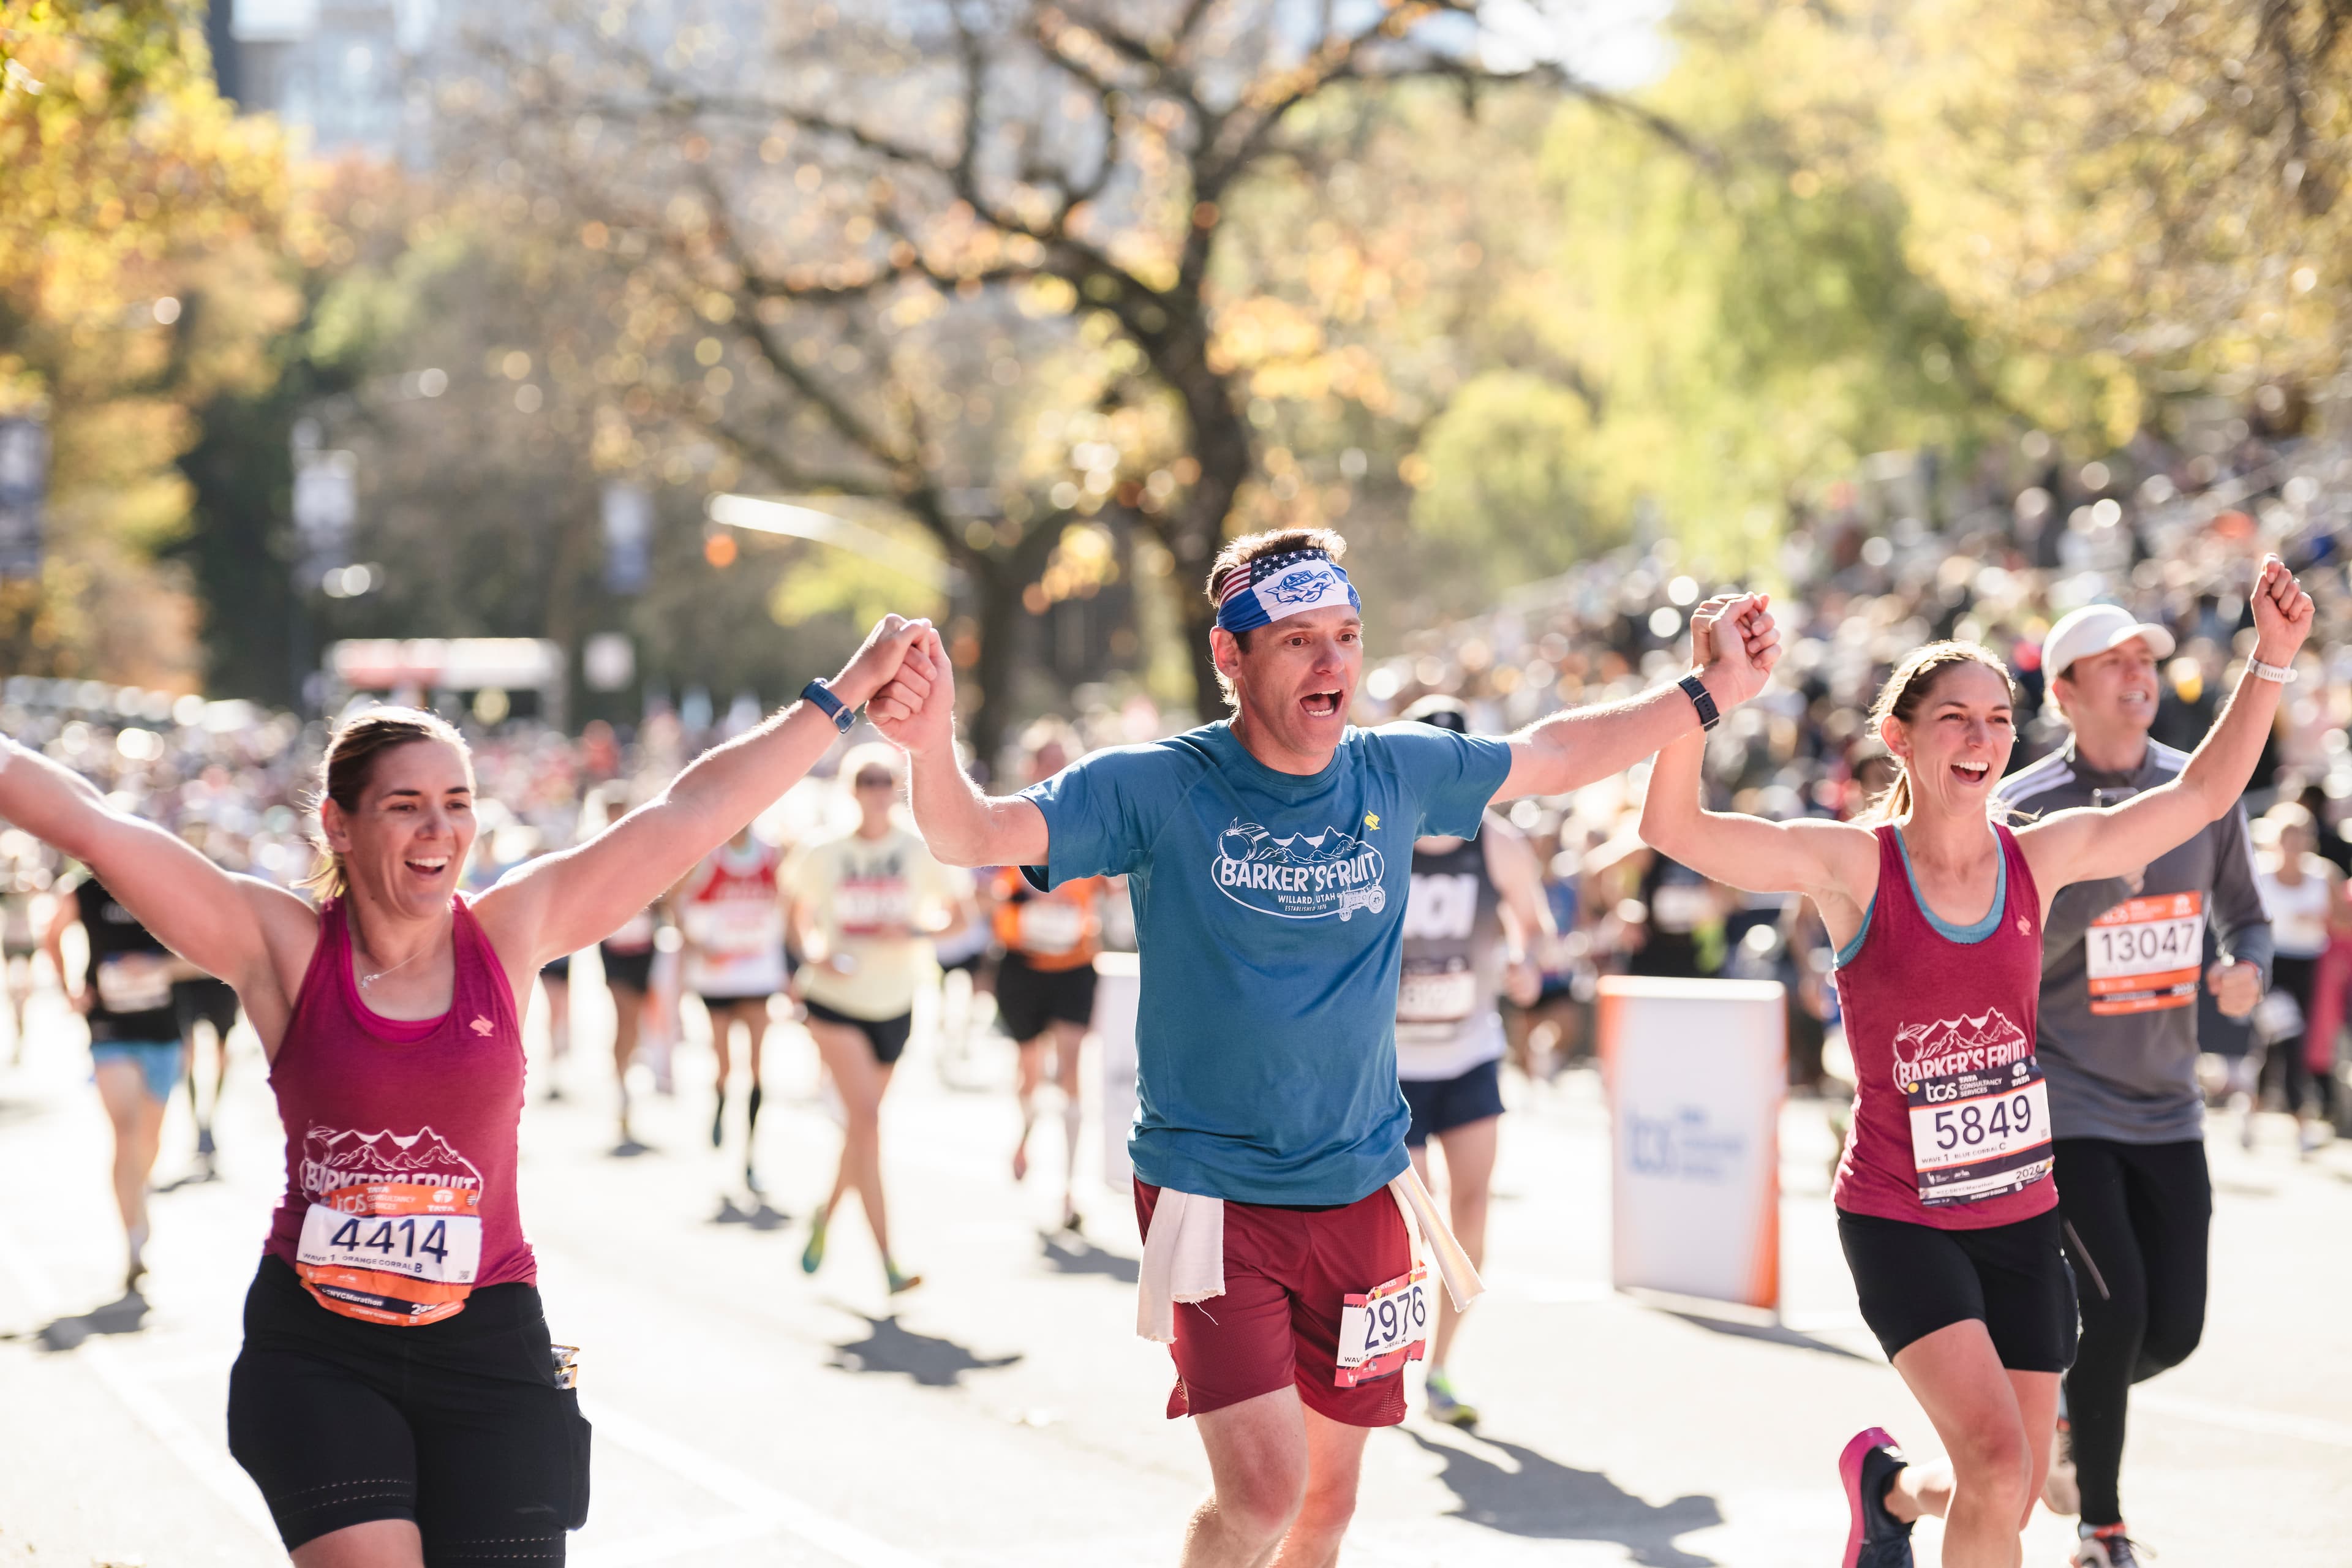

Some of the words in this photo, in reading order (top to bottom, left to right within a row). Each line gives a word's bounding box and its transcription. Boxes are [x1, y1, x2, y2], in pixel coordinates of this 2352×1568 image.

[1220, 859, 1327, 892] BARKER'S
[1327, 852, 1378, 887] FRUIT
[1278, 895, 1314, 905] WILLARD,
[1316, 892, 1335, 903] UTAH
[2102, 923, 2195, 962] 13047
[1900, 1049, 1985, 1088] BARKER'S
[1986, 1038, 2026, 1069] FRUIT
[1958, 1074, 1978, 1083] TATA
[1959, 1078, 2002, 1090] CONSULTANCY
[2011, 1074, 2030, 1087] TATA
[1924, 1081, 1958, 1102] tcs
[1960, 1087, 1988, 1098] SERVICES
[1935, 1095, 2031, 1150] 5849
[331, 1217, 448, 1264] 4414
[303, 1253, 326, 1262] WAVE
[342, 1256, 377, 1265] ORANGE
[379, 1259, 412, 1271] CORRAL
[414, 1262, 423, 1273] B
[1365, 1286, 1425, 1351] 2976
